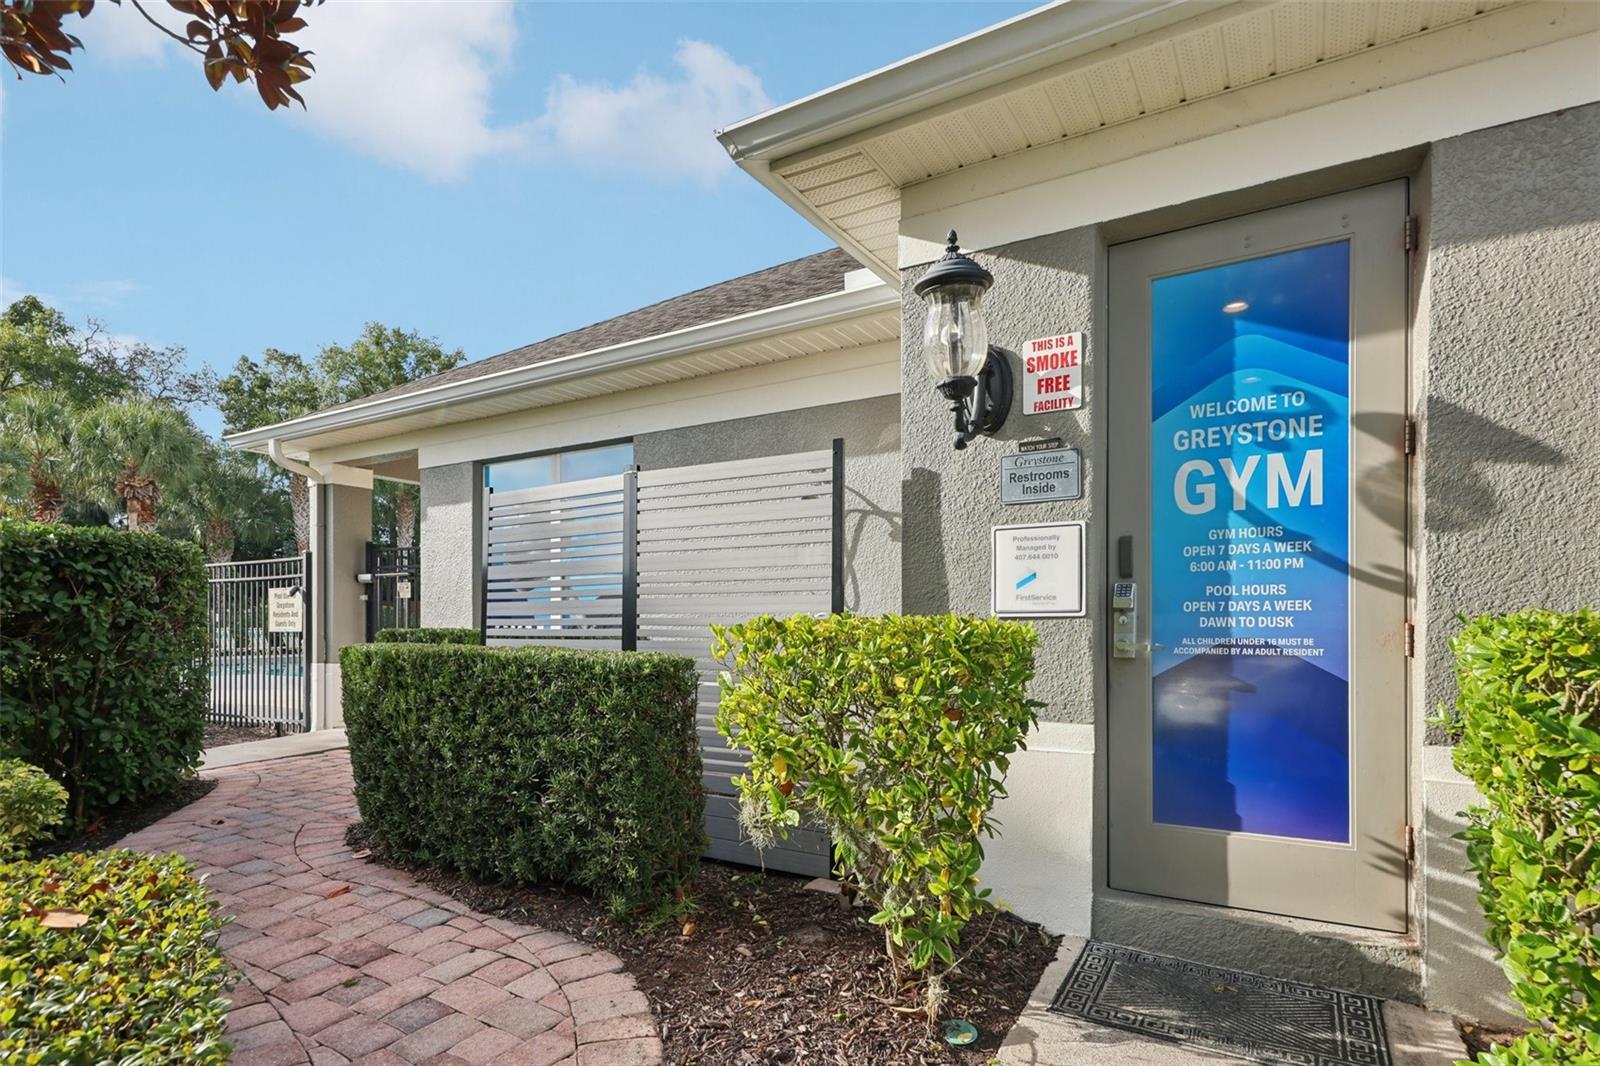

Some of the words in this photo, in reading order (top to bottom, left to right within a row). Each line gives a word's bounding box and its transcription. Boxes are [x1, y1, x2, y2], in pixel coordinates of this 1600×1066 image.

[1032, 339, 1053, 352] THIS
[1056, 337, 1065, 348] IS
[1067, 336, 1073, 346] A
[1026, 350, 1078, 373] SMOKE
[1038, 374, 1070, 394] FREE
[1034, 397, 1074, 412] FACILITY
[1190, 394, 1277, 419] WELCOME
[1281, 391, 1305, 408] TO
[1173, 414, 1323, 451] GREYSTONE
[1014, 455, 1064, 467] Greystone
[1009, 470, 1070, 484] Restrooms
[1174, 448, 1323, 515] GYM
[1022, 482, 1056, 495] Inside
[1012, 534, 1060, 542] Professionally
[1208, 528, 1235, 540] GYM
[1238, 526, 1284, 538] HOURS
[1016, 544, 1046, 552] Managed
[1048, 543, 1056, 551] by
[1183, 545, 1215, 557] OPEN
[1218, 545, 1225, 556] 7
[1228, 543, 1260, 555] DAYS
[1262, 543, 1272, 554] A
[1274, 540, 1312, 552] WEEK
[1190, 561, 1215, 572] 6:00
[1218, 560, 1236, 571] AM
[1247, 558, 1280, 570] 11:00
[1284, 558, 1304, 569] PM
[1016, 593, 1056, 601] FirstService
[1206, 585, 1238, 596] POOL
[1242, 584, 1286, 596] HOURS
[1183, 601, 1215, 612] OPEN
[1218, 602, 1225, 612] 7
[1228, 600, 1260, 612] DAYS
[1262, 601, 1272, 611] A
[1274, 600, 1312, 611] WEEK
[1200, 616, 1236, 628] DAWN
[1238, 616, 1255, 628] TO
[1258, 616, 1294, 628] DUSK
[1238, 638, 1264, 646] UNDER
[1268, 638, 1276, 646] 16
[1278, 638, 1302, 646] MUST
[1303, 638, 1314, 646] BE
[1174, 647, 1230, 655] ACCOMPANIED
[1242, 648, 1254, 656] AN
[1254, 648, 1282, 656] ADULT
[1282, 648, 1324, 656] RESIDENT
